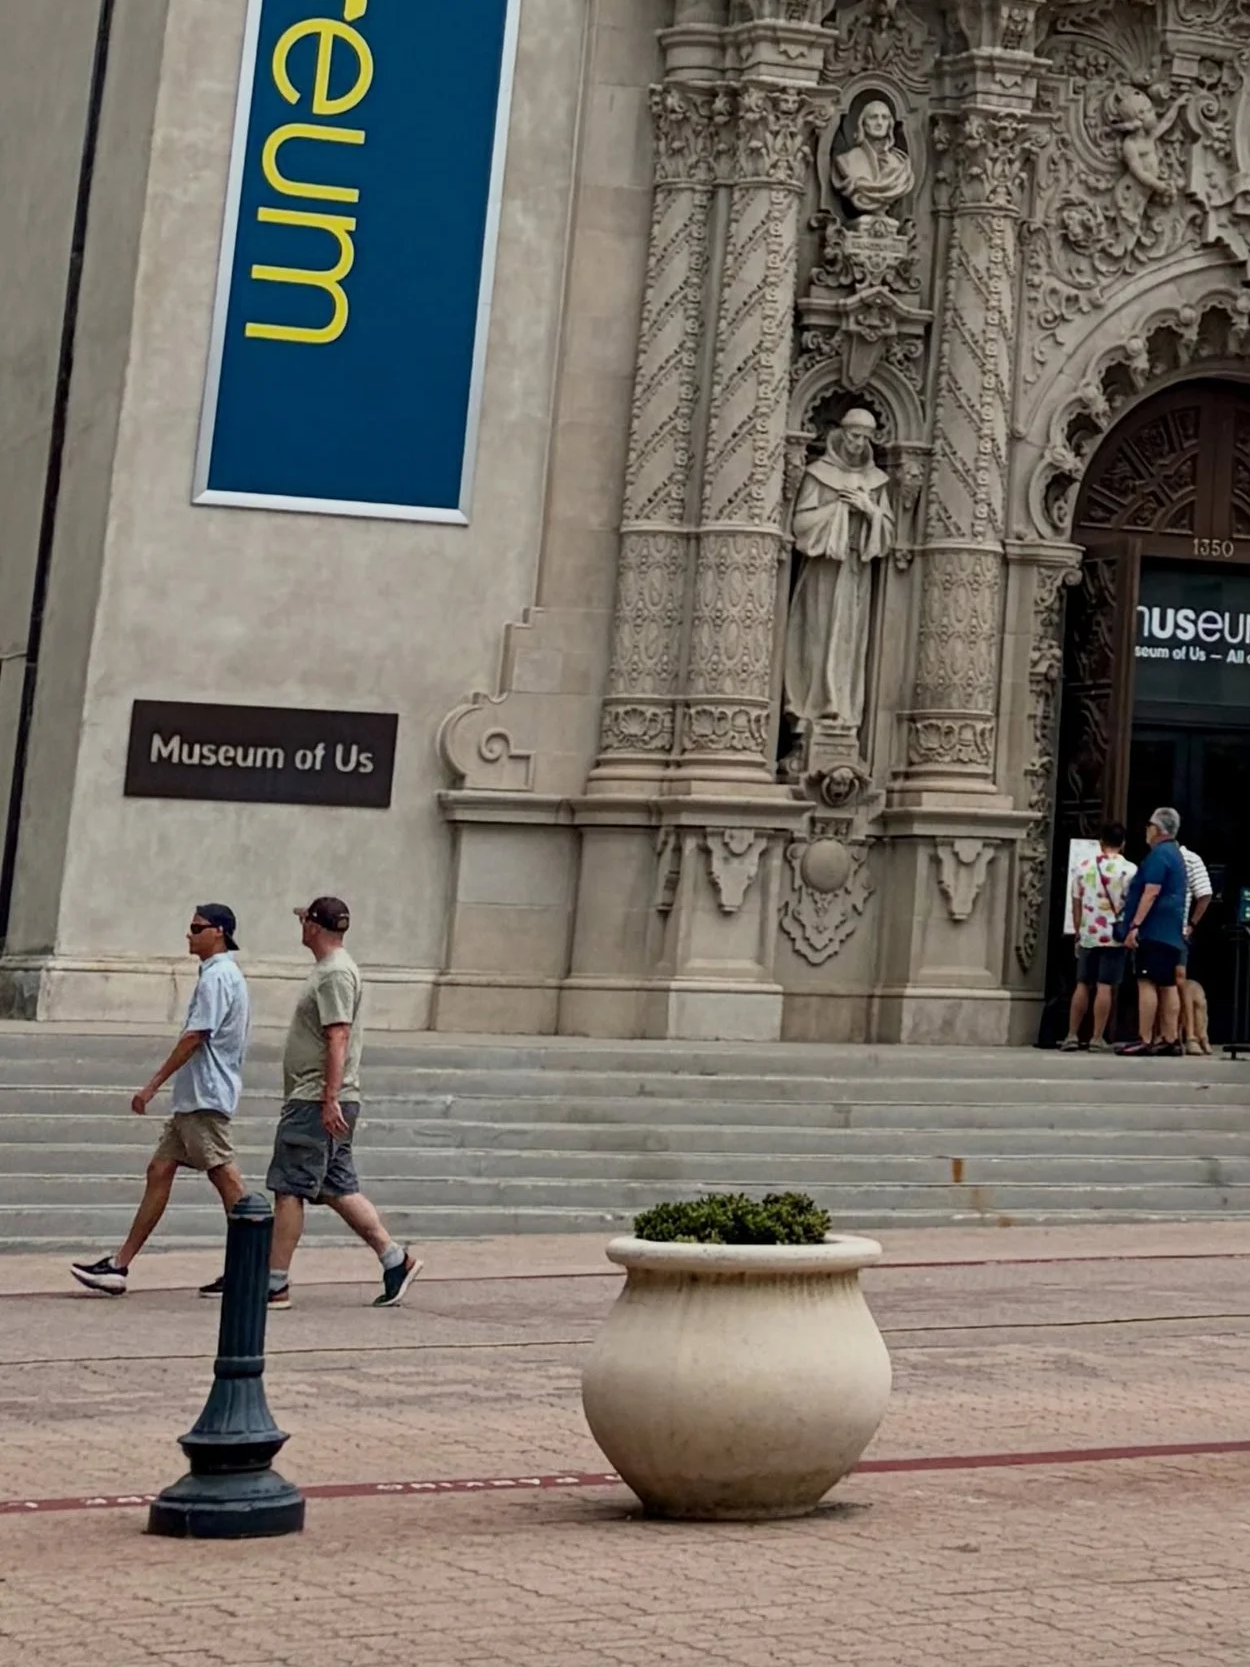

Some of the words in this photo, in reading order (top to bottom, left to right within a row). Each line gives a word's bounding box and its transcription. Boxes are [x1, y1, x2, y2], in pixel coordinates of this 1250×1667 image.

[1193, 537, 1235, 558] 1350
[1134, 645, 1170, 659] seum
[1172, 645, 1187, 660] of
[1189, 646, 1207, 662] Us
[1226, 649, 1245, 664] All
[150, 733, 285, 770] Museum
[294, 742, 326, 771] of
[334, 743, 375, 774] Us
